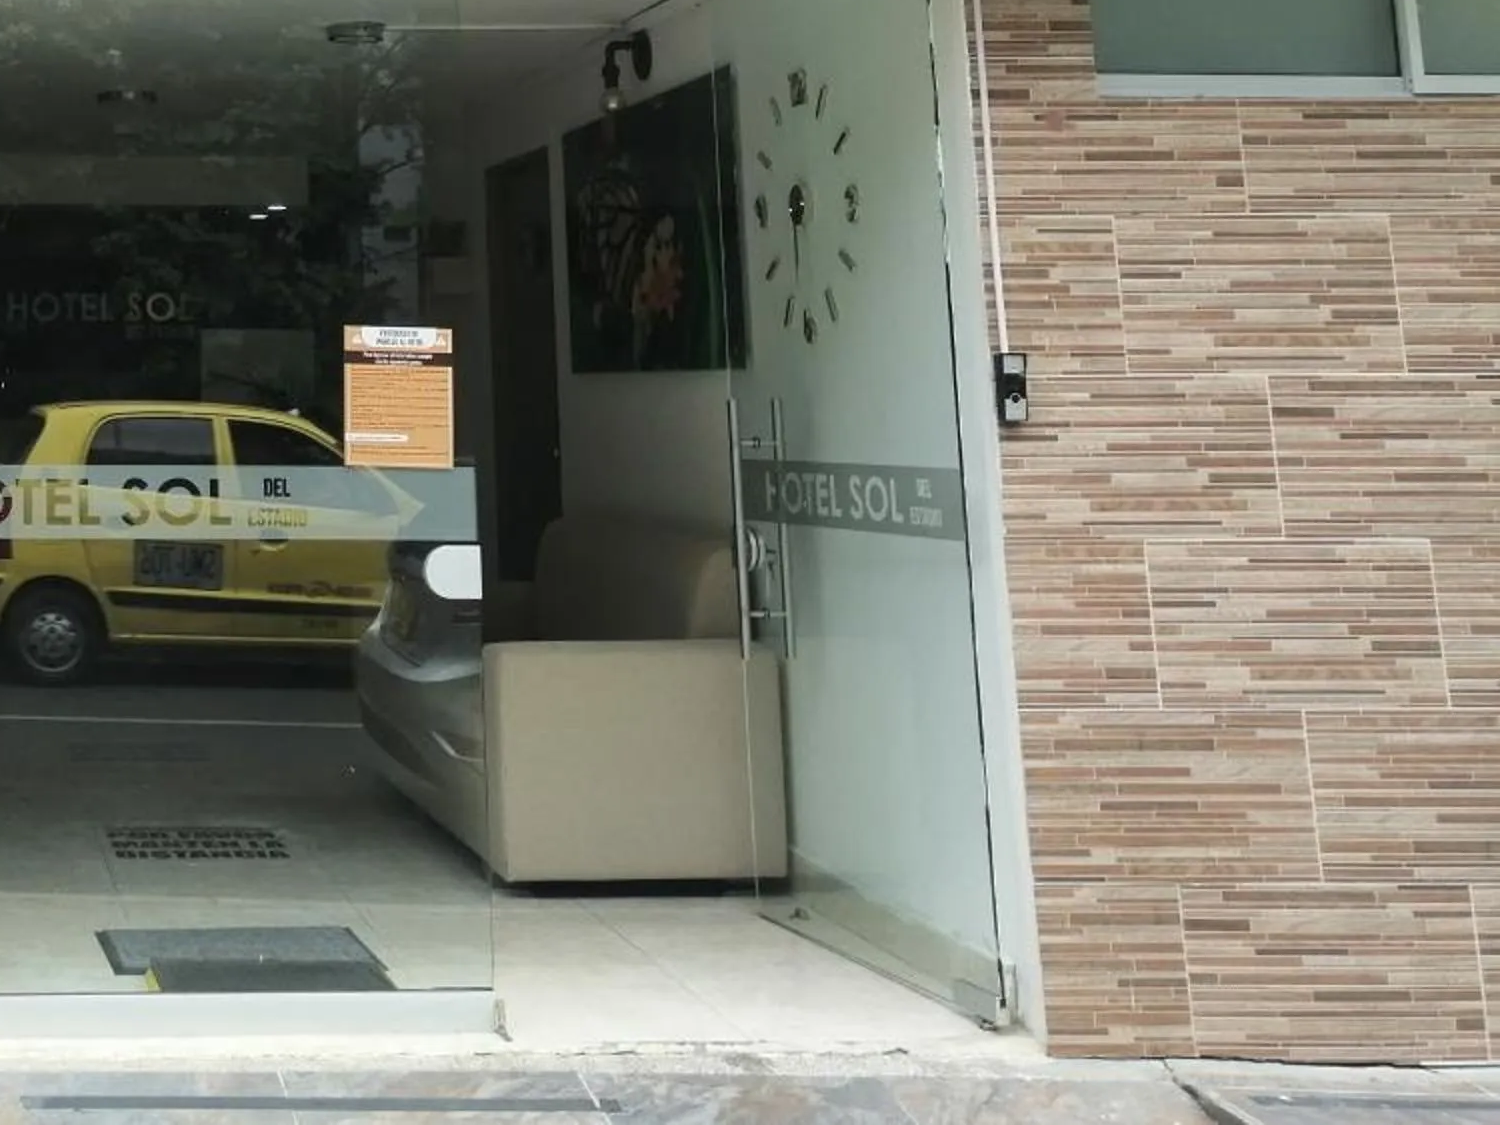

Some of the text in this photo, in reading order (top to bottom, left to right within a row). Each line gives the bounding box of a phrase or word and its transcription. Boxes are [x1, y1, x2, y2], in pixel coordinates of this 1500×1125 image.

[6, 290, 203, 322] HOTEL SOL
[121, 477, 232, 527] SOL
[263, 477, 291, 499] DEL
[765, 471, 904, 524] HOTEL SOL
[247, 507, 308, 529] ESTADIO
